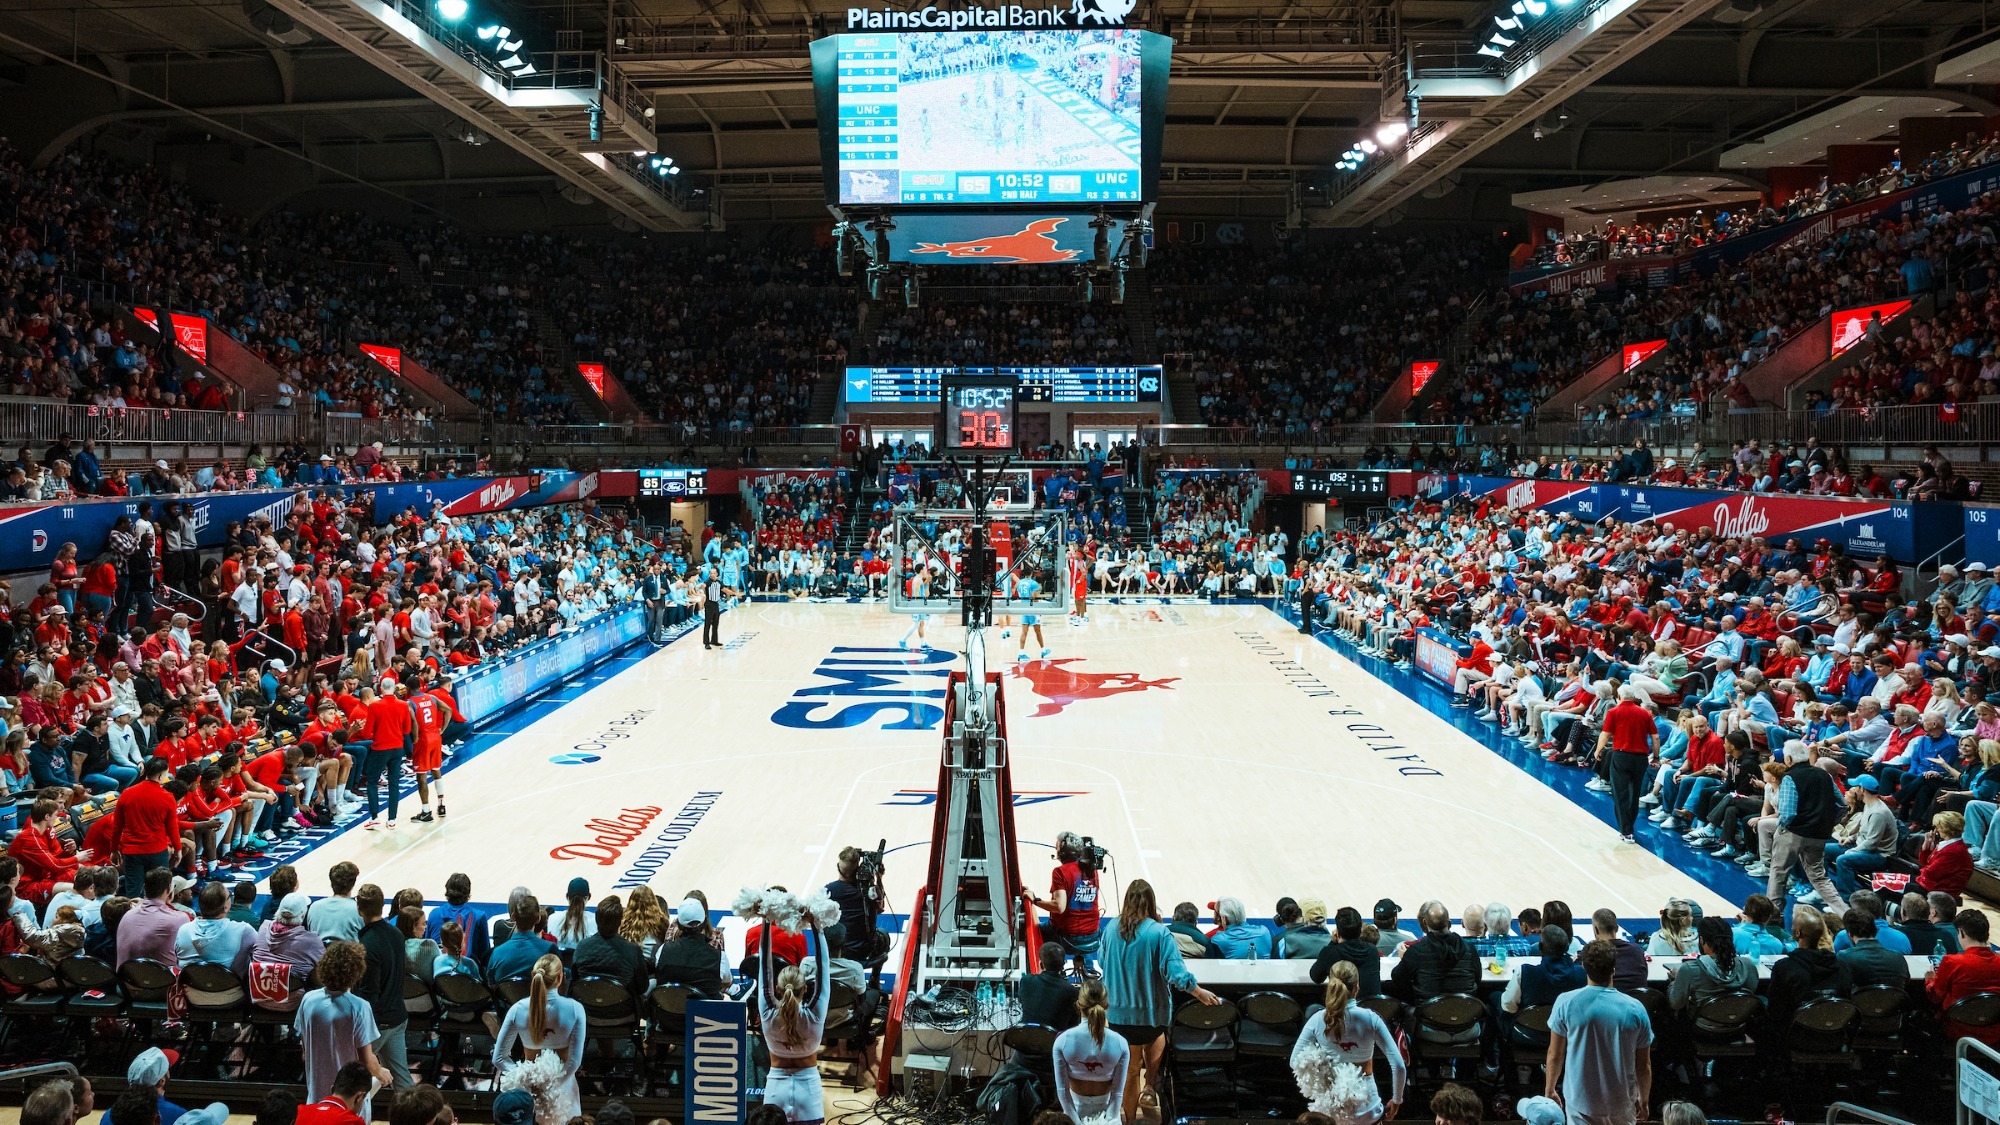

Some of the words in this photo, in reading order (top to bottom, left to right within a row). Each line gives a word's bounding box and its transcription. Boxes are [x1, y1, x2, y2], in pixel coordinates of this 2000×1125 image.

[856, 105, 881, 114] UNC
[995, 174, 1044, 188] 10:52
[1095, 173, 1128, 184] UNC
[963, 180, 986, 192] 65
[947, 192, 954, 200] 2
[1001, 190, 1018, 199] 2ND
[1019, 190, 1038, 199] HALF
[1102, 191, 1110, 199] 3
[1130, 191, 1137, 199] 3
[1581, 265, 1607, 287] FAME
[960, 388, 1007, 409] 10:52
[961, 411, 1001, 447] 30
[644, 478, 658, 488] 65
[689, 478, 703, 488] 61
[1329, 472, 1348, 482] 10:52
[1294, 482, 1305, 490] 65
[1372, 483, 1384, 492] 61
[1590, 486, 1598, 494] 103
[1506, 479, 1536, 513] MUSTANGS
[1620, 488, 1629, 497] 104
[125, 504, 138, 514] 112
[1578, 500, 1593, 513] SMU
[62, 508, 74, 519] 111
[1713, 495, 1770, 539] Dallas
[1892, 507, 1908, 519] 104
[1968, 510, 1987, 523] 105
[1234, 631, 1285, 656] COURT
[1270, 660, 1340, 698] MILLER
[770, 646, 958, 731] SMU
[423, 708, 432, 724] 2
[573, 727, 631, 751] Origin
[608, 709, 655, 726] Bank
[1346, 723, 1444, 777] DAVID
[549, 805, 663, 866] Dallas
[611, 842, 679, 890] MOODY
[657, 790, 723, 842] COLISEUM
[1074, 894, 1096, 903] TAMED
[693, 1015, 738, 1122] MOODY
